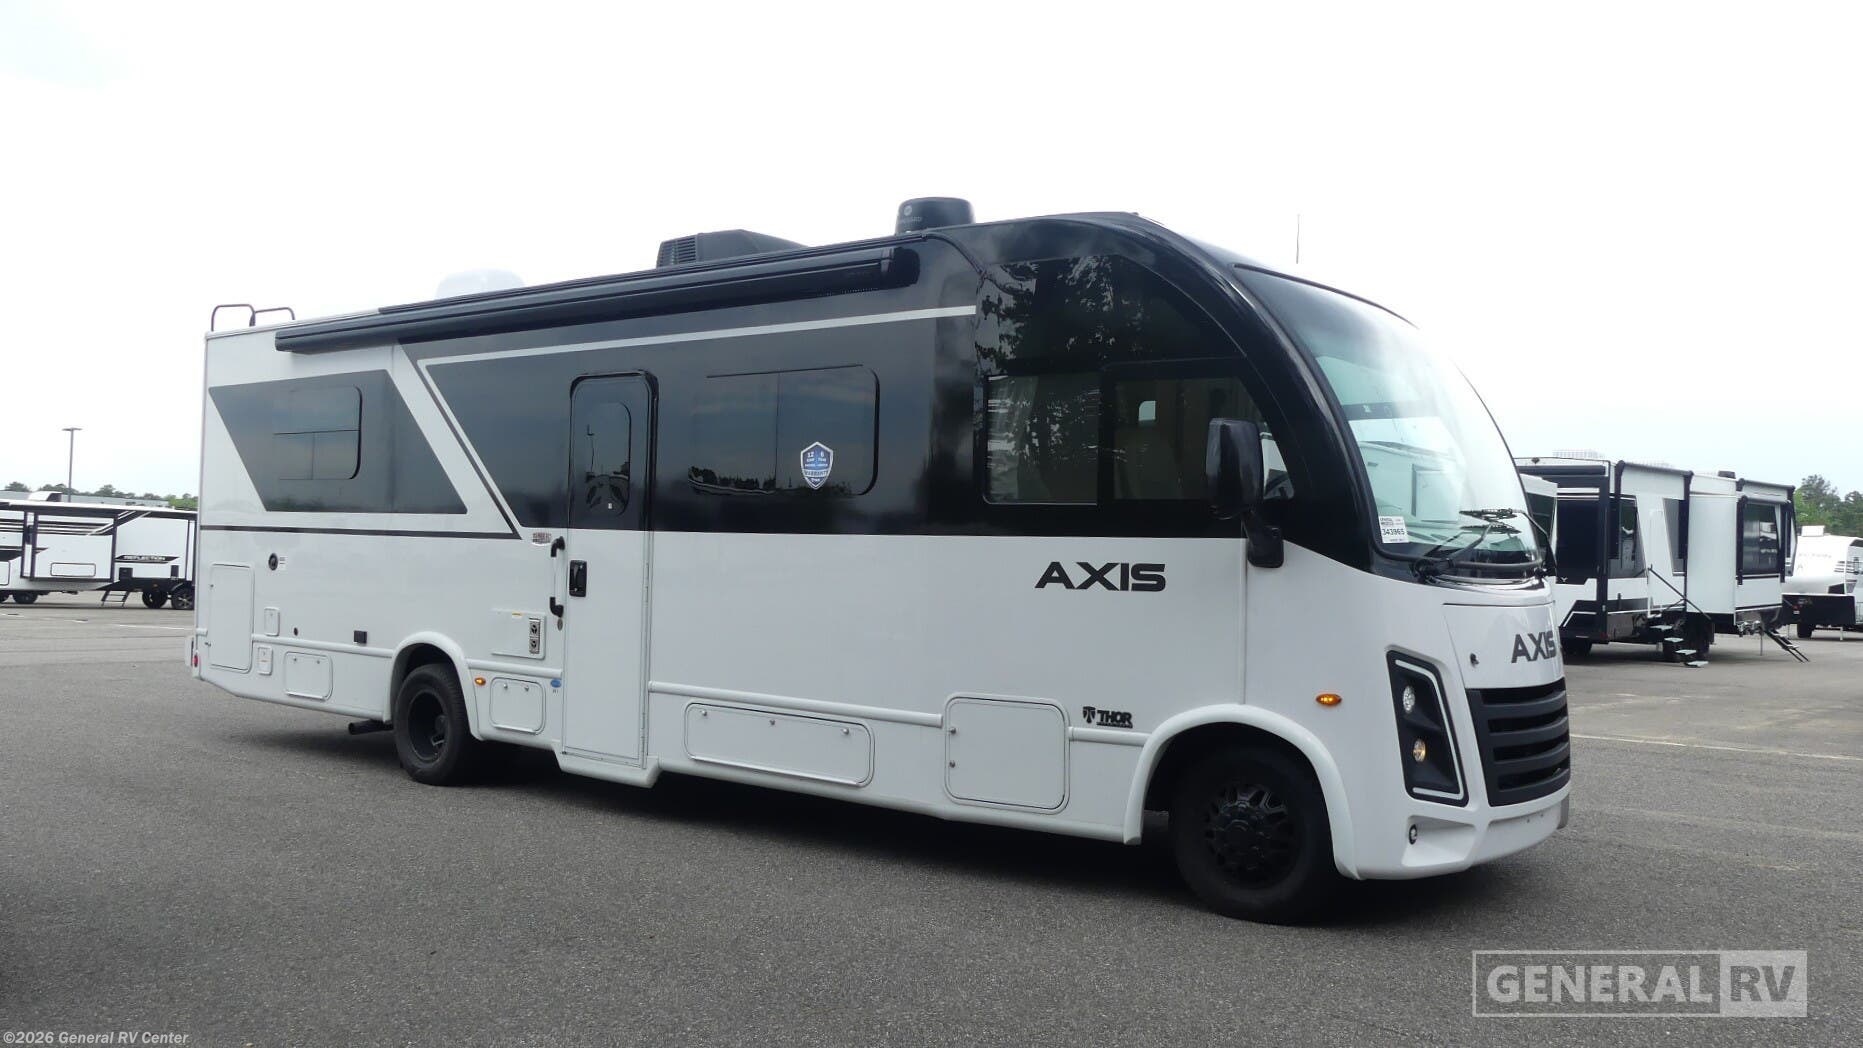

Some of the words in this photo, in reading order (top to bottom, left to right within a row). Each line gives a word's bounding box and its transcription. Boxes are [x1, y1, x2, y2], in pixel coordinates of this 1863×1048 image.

[1034, 561, 1166, 592] AXIS
[1511, 630, 1556, 664] AXIS
[1097, 709, 1132, 725] THOR
